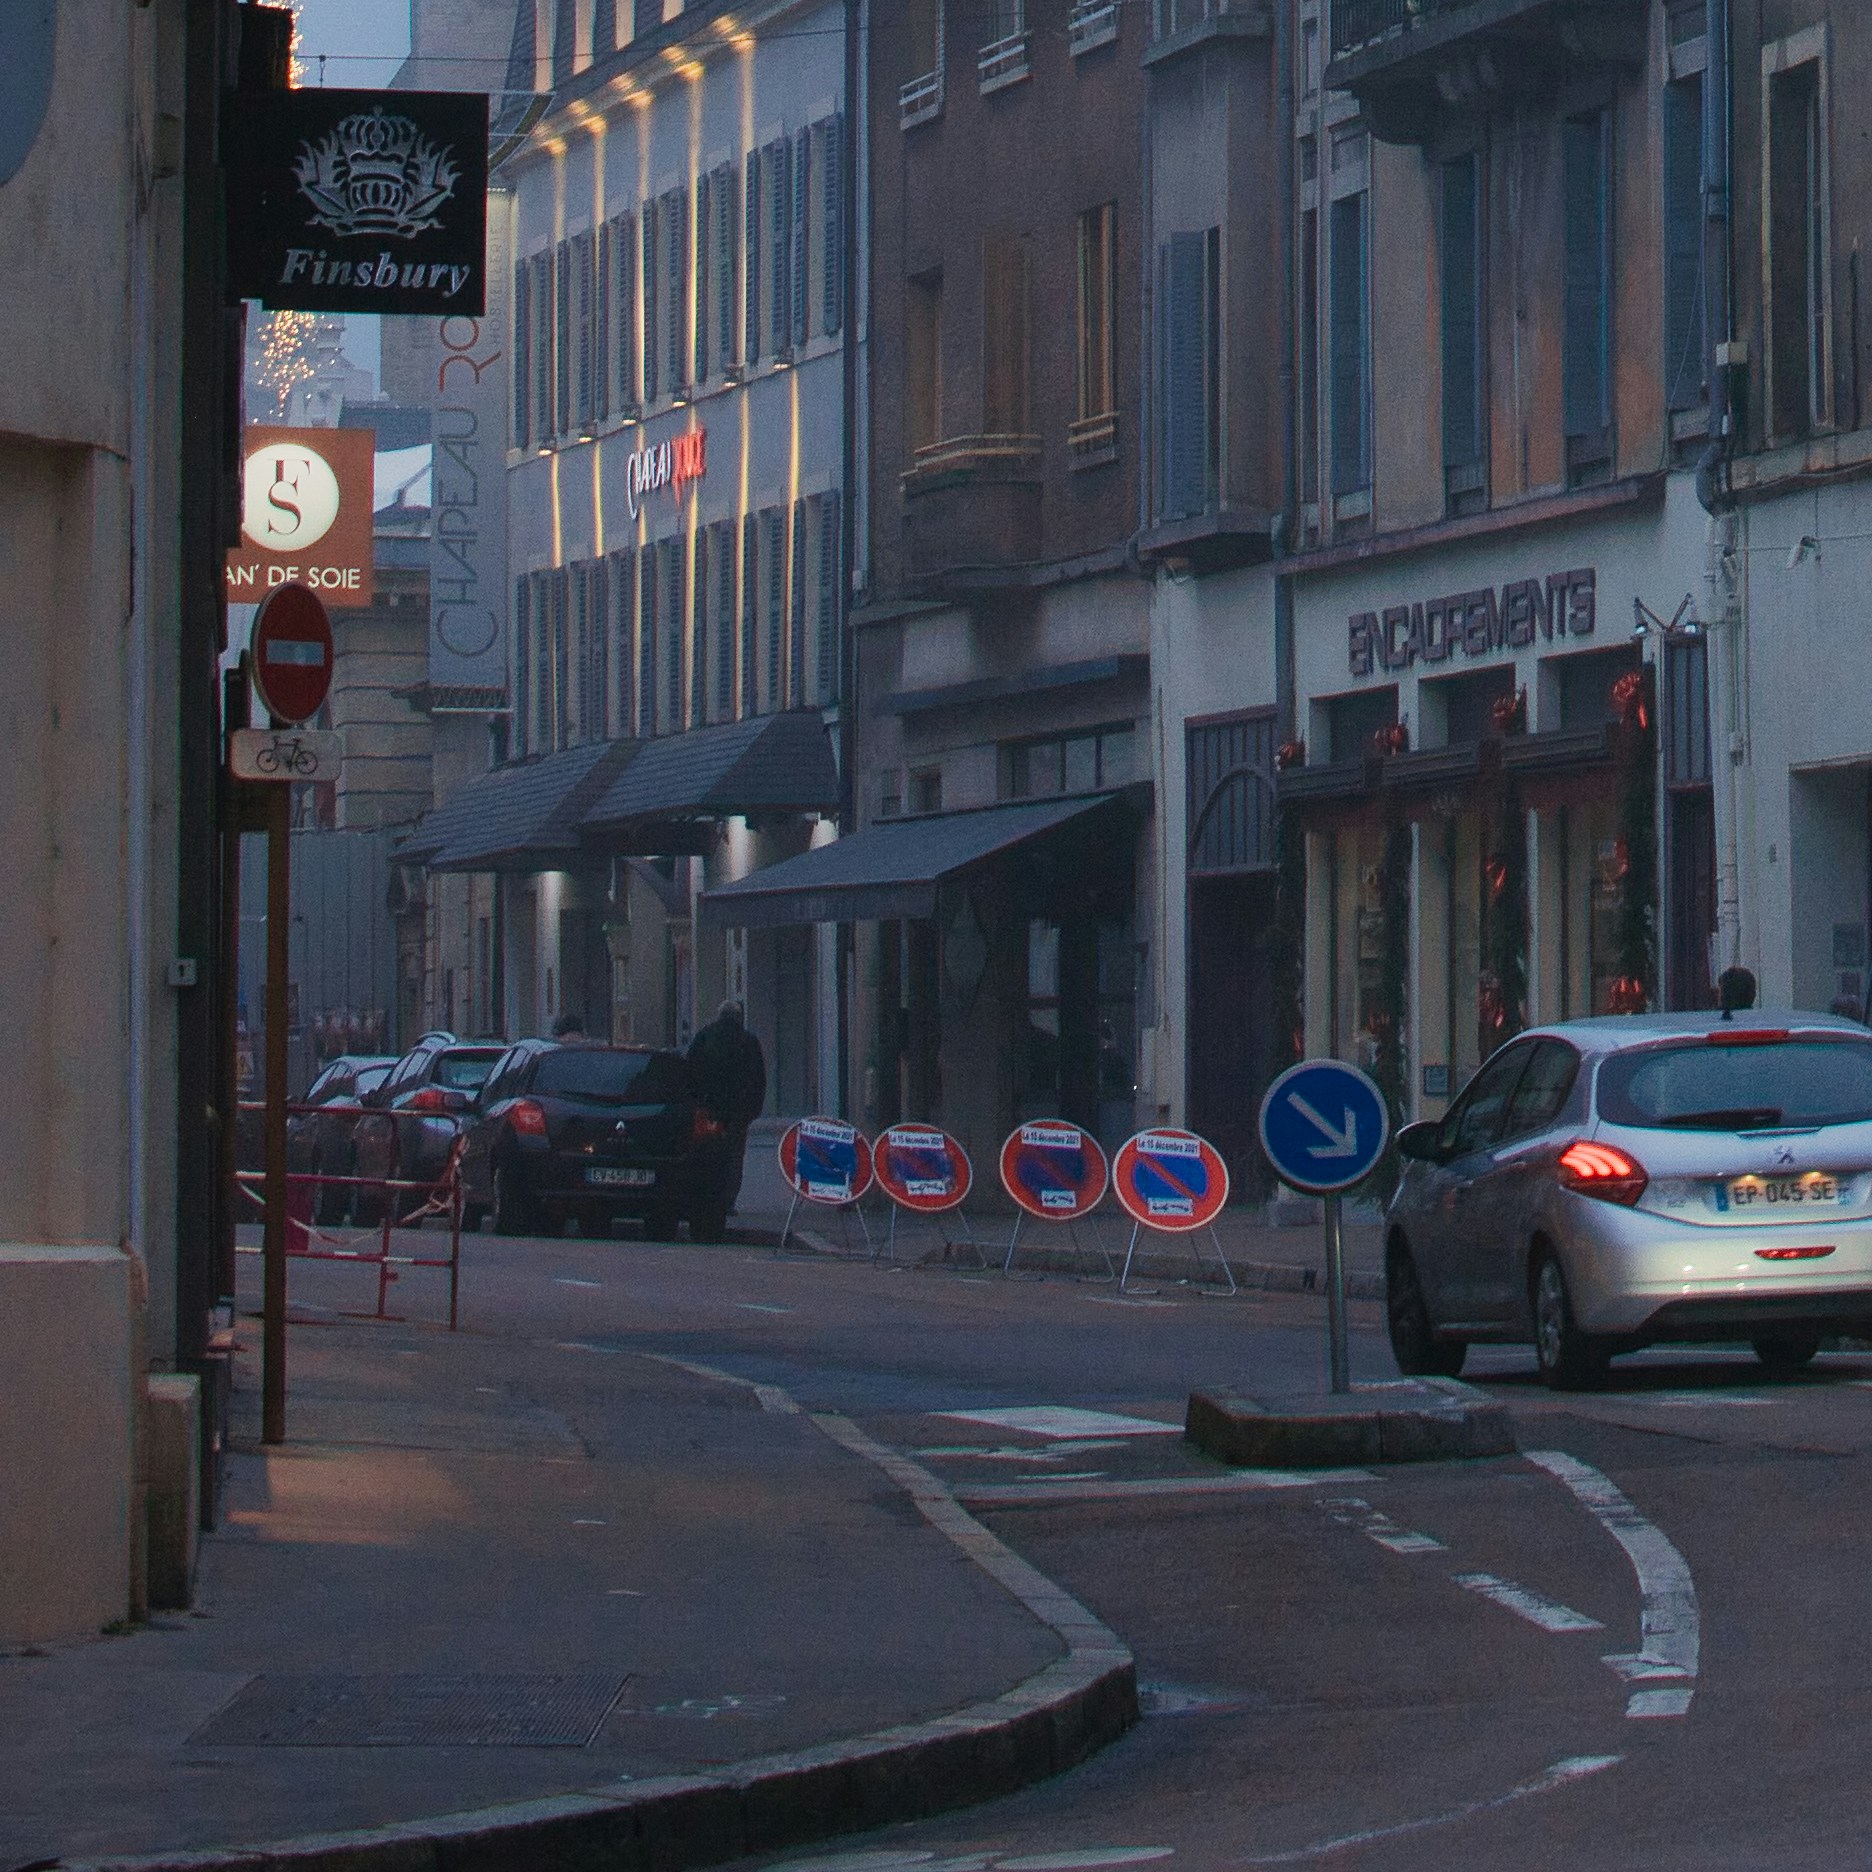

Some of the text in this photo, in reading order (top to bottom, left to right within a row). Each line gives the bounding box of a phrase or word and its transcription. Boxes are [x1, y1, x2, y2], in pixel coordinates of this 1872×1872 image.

[280, 249, 470, 298] Finsbury
[437, 406, 497, 657] CHAPEAU
[307, 567, 361, 589] SOIE
[1348, 567, 1596, 676] ENCADREMENTS
[1733, 1180, 1836, 1205] EP-045-SE
